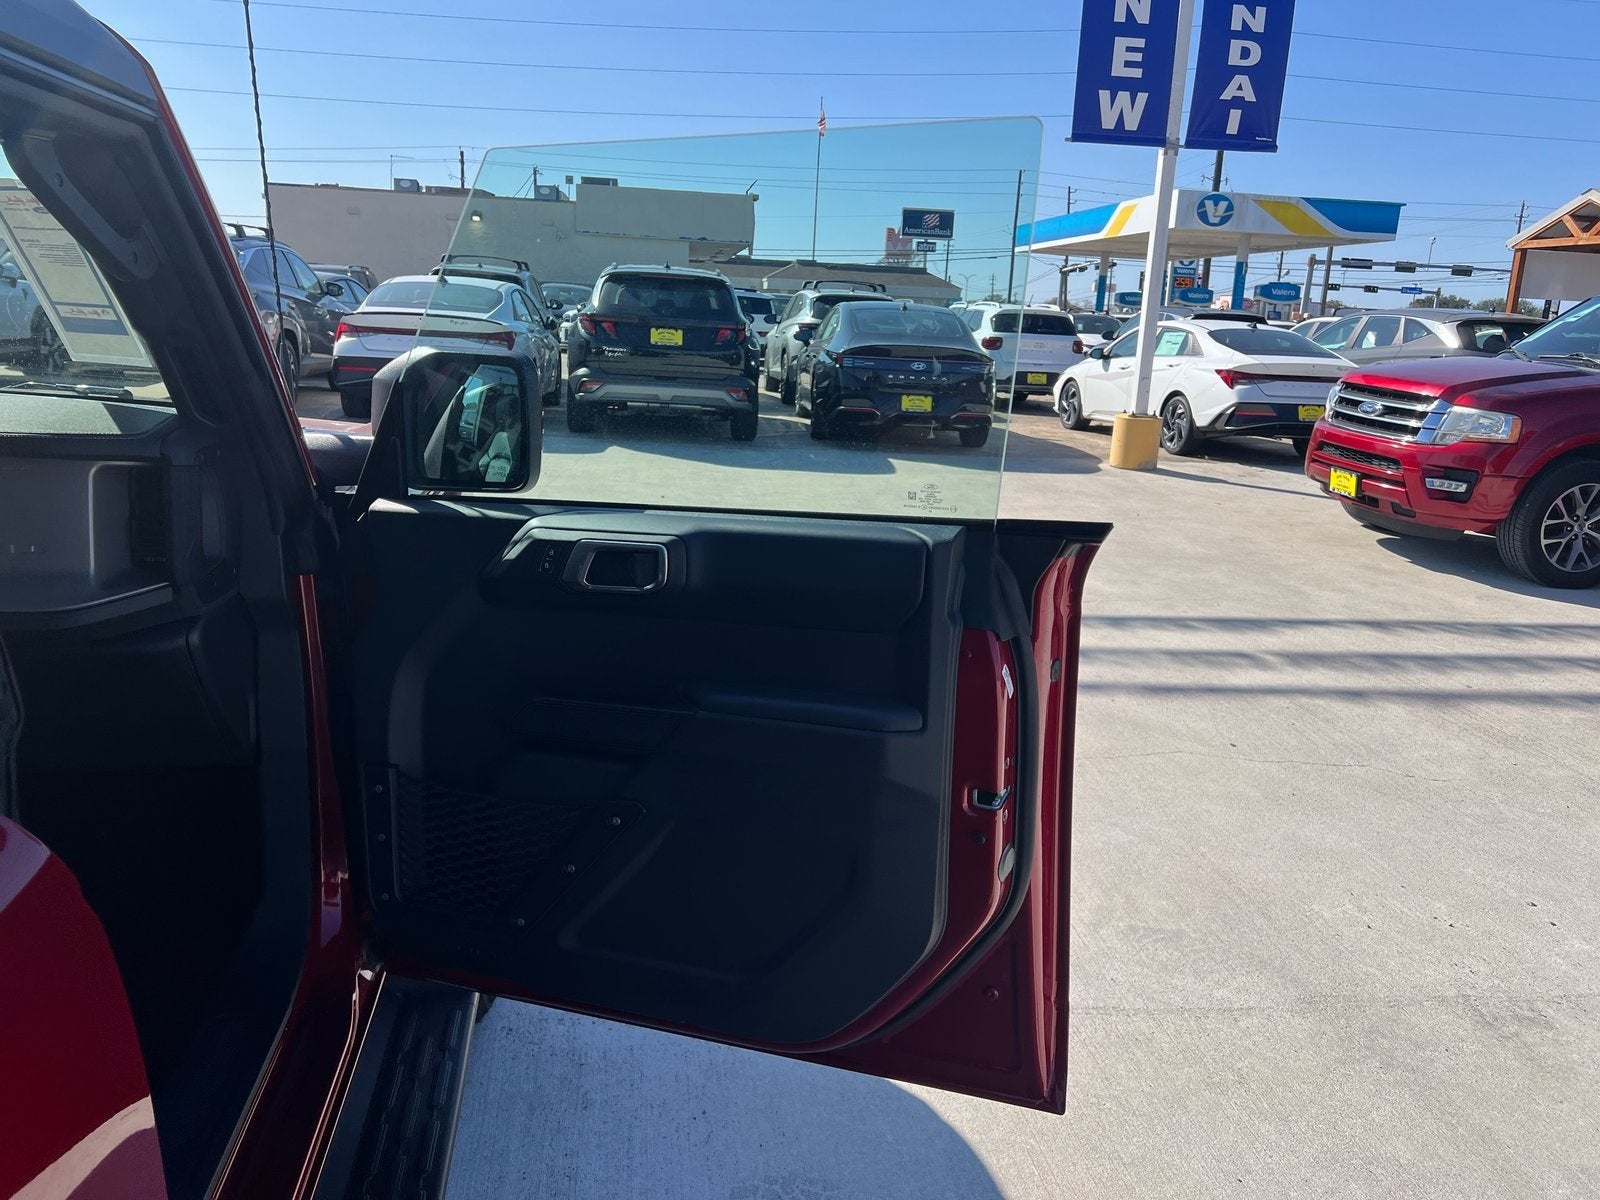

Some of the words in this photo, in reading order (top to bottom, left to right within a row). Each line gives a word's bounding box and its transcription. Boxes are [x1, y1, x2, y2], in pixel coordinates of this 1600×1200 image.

[1098, 0, 1150, 131] NEW
[904, 226, 951, 236] AmericanBank
[917, 242, 936, 250] atm
[1271, 288, 1296, 297] Valero
